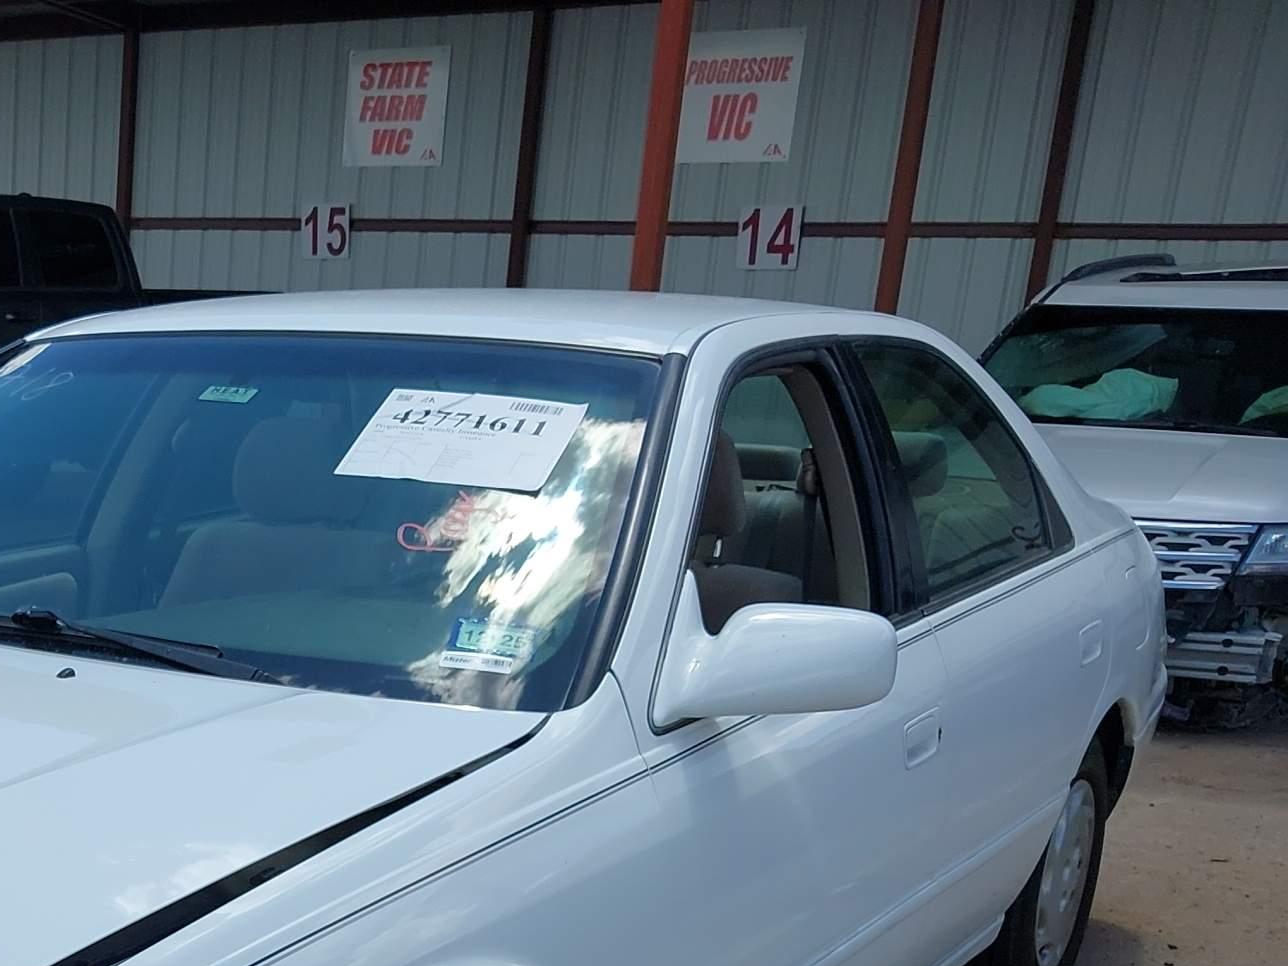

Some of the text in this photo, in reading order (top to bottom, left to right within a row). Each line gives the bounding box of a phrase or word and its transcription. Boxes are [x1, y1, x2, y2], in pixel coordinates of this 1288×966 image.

[359, 61, 433, 91] STATE
[686, 56, 794, 85] PROGRESSIVE
[358, 95, 427, 123] FARM
[707, 92, 758, 141] VIC
[371, 128, 414, 155] VIC
[304, 206, 347, 256] 15
[741, 207, 794, 265] 14
[392, 408, 547, 437] 42771611
[499, 634, 528, 649] 25
